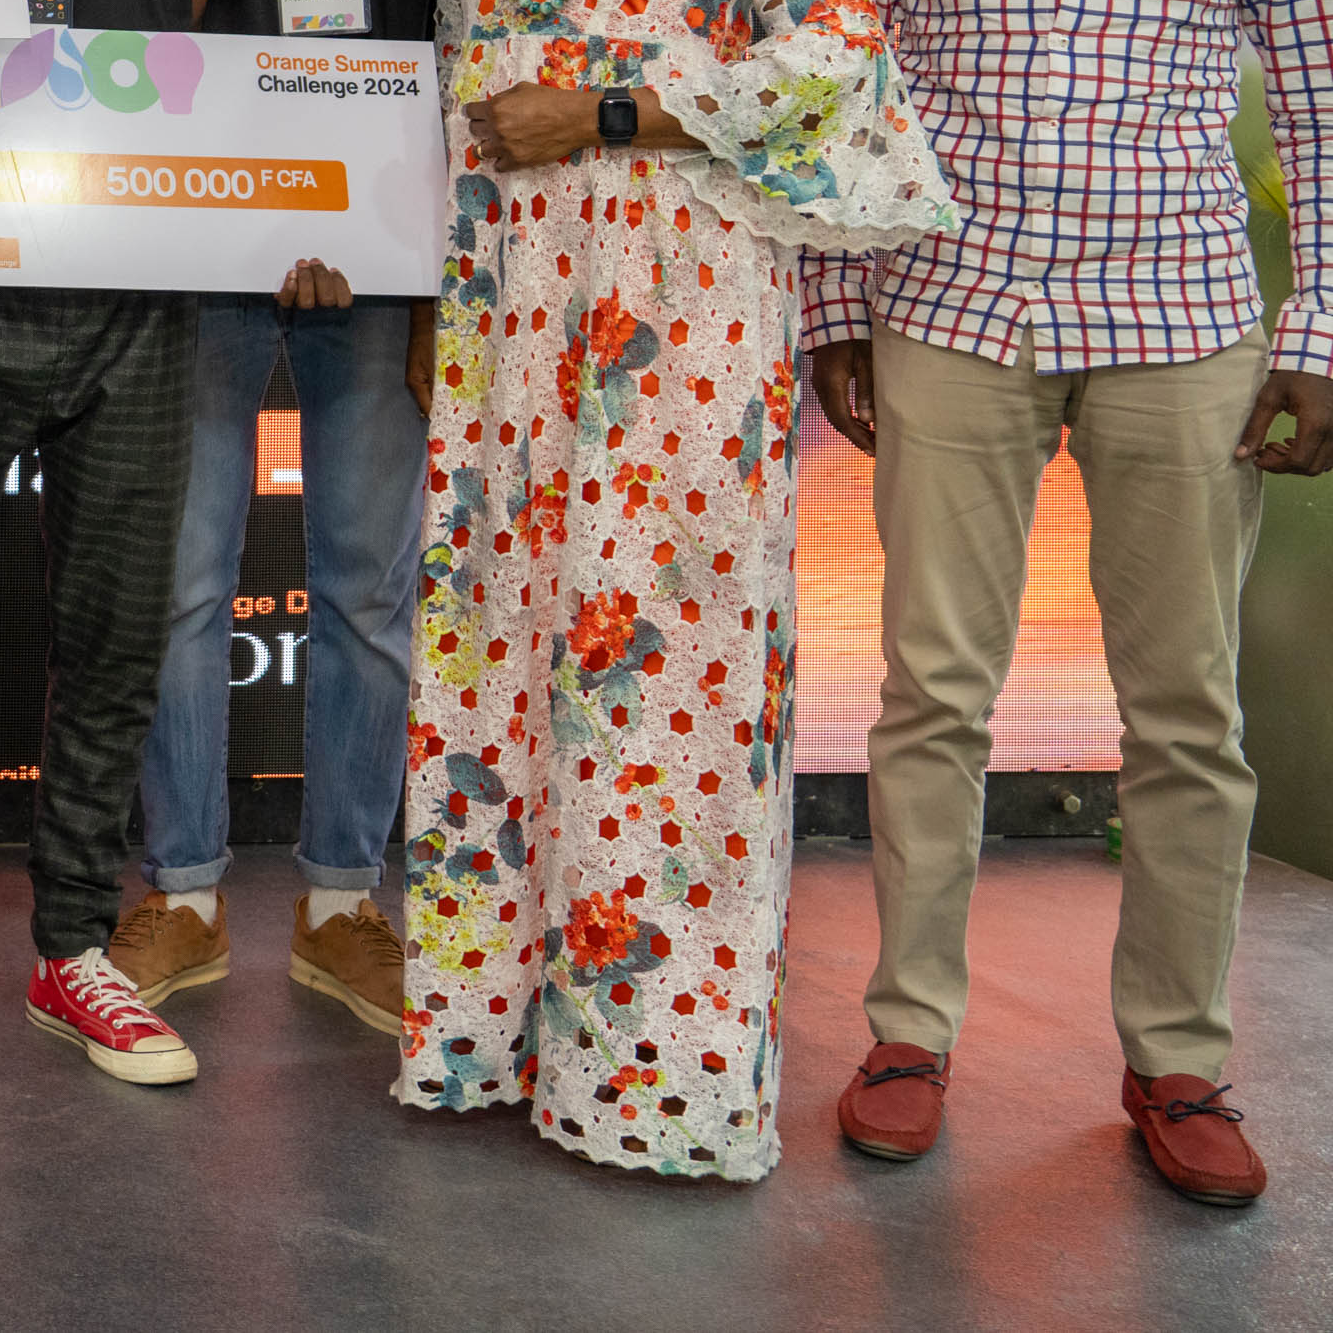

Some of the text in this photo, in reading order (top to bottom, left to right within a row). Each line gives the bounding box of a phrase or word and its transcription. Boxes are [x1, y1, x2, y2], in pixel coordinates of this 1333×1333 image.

[256, 52, 419, 75] Orange Summer
[258, 74, 420, 98] Challenge 2024
[107, 166, 318, 200] 500 000 F CFA
